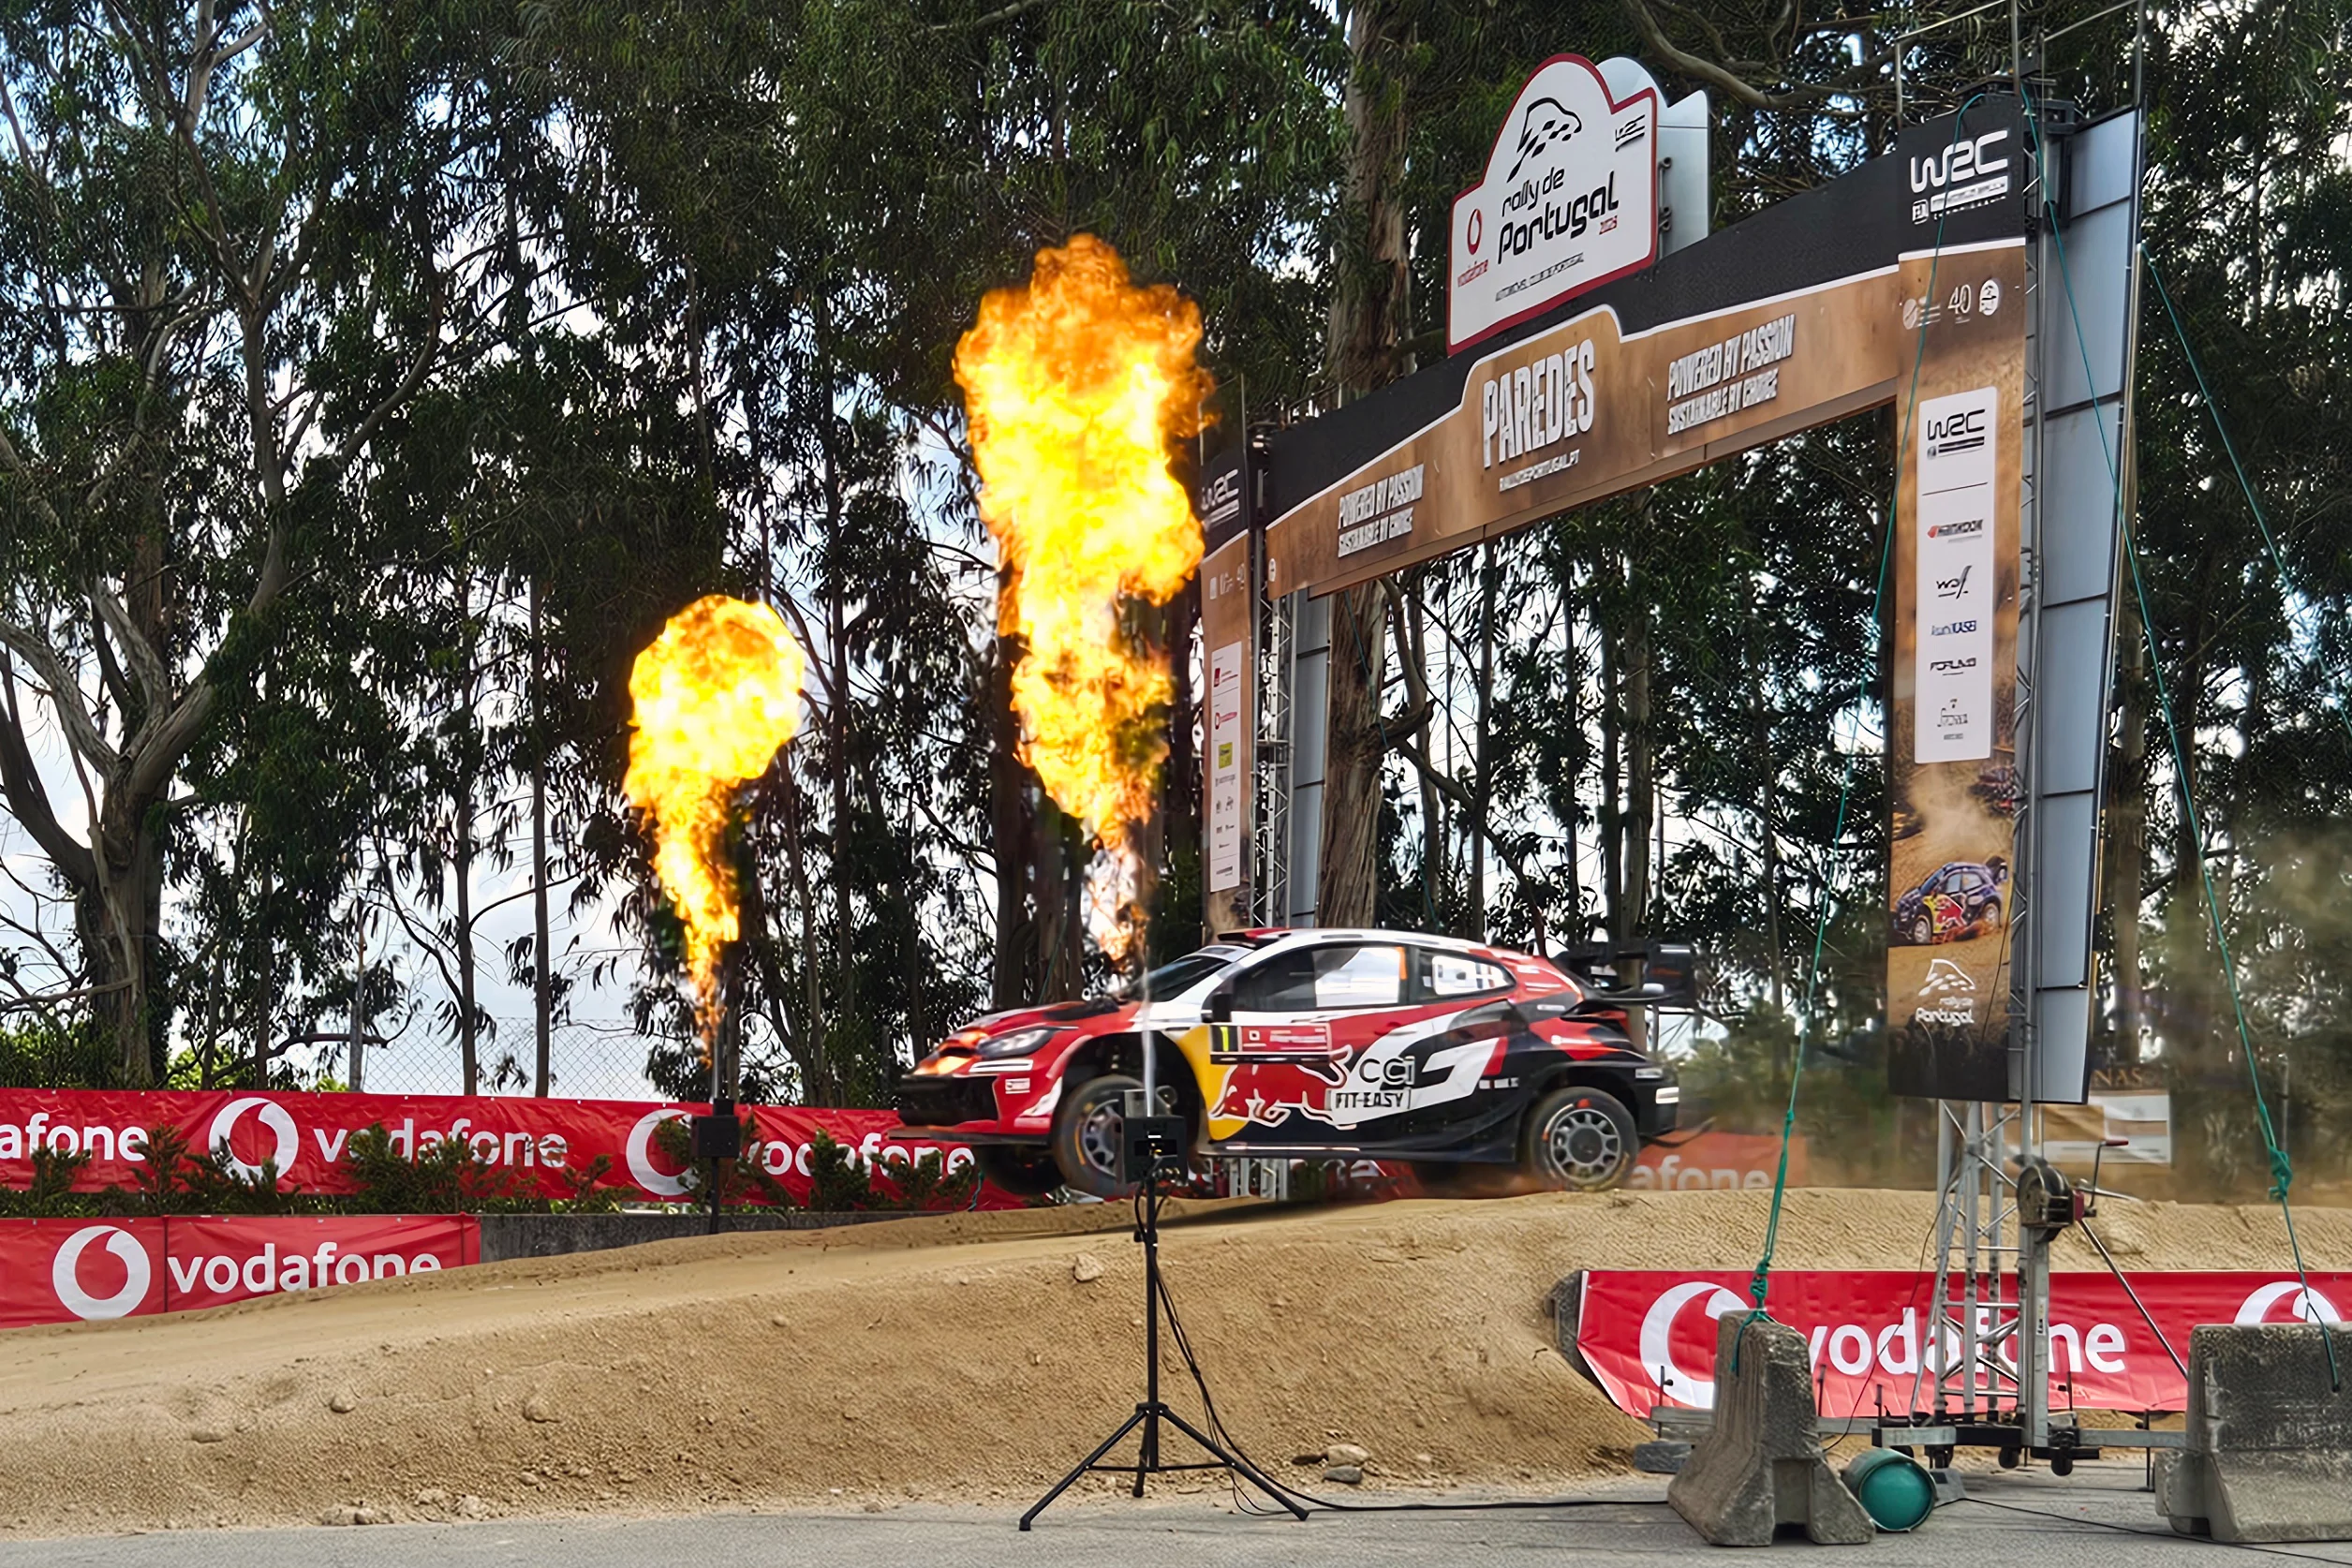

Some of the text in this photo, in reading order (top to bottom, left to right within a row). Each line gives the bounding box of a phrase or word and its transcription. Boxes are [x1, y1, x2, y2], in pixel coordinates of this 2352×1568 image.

[1910, 129, 2009, 193] WRC
[1501, 166, 1565, 217] rally de
[1496, 170, 1620, 265] Portugal
[1947, 284, 1972, 315] 40
[1483, 338, 1595, 468] PAREDES
[1927, 408, 1986, 441] WRC
[1915, 1007, 1975, 1027] Portugal
[2093, 1066, 2144, 1087] NAS
[1335, 1091, 1405, 1109] FIT-EASY
[1631, 1154, 1770, 1191] afone
[167, 1241, 442, 1294] vodafone
